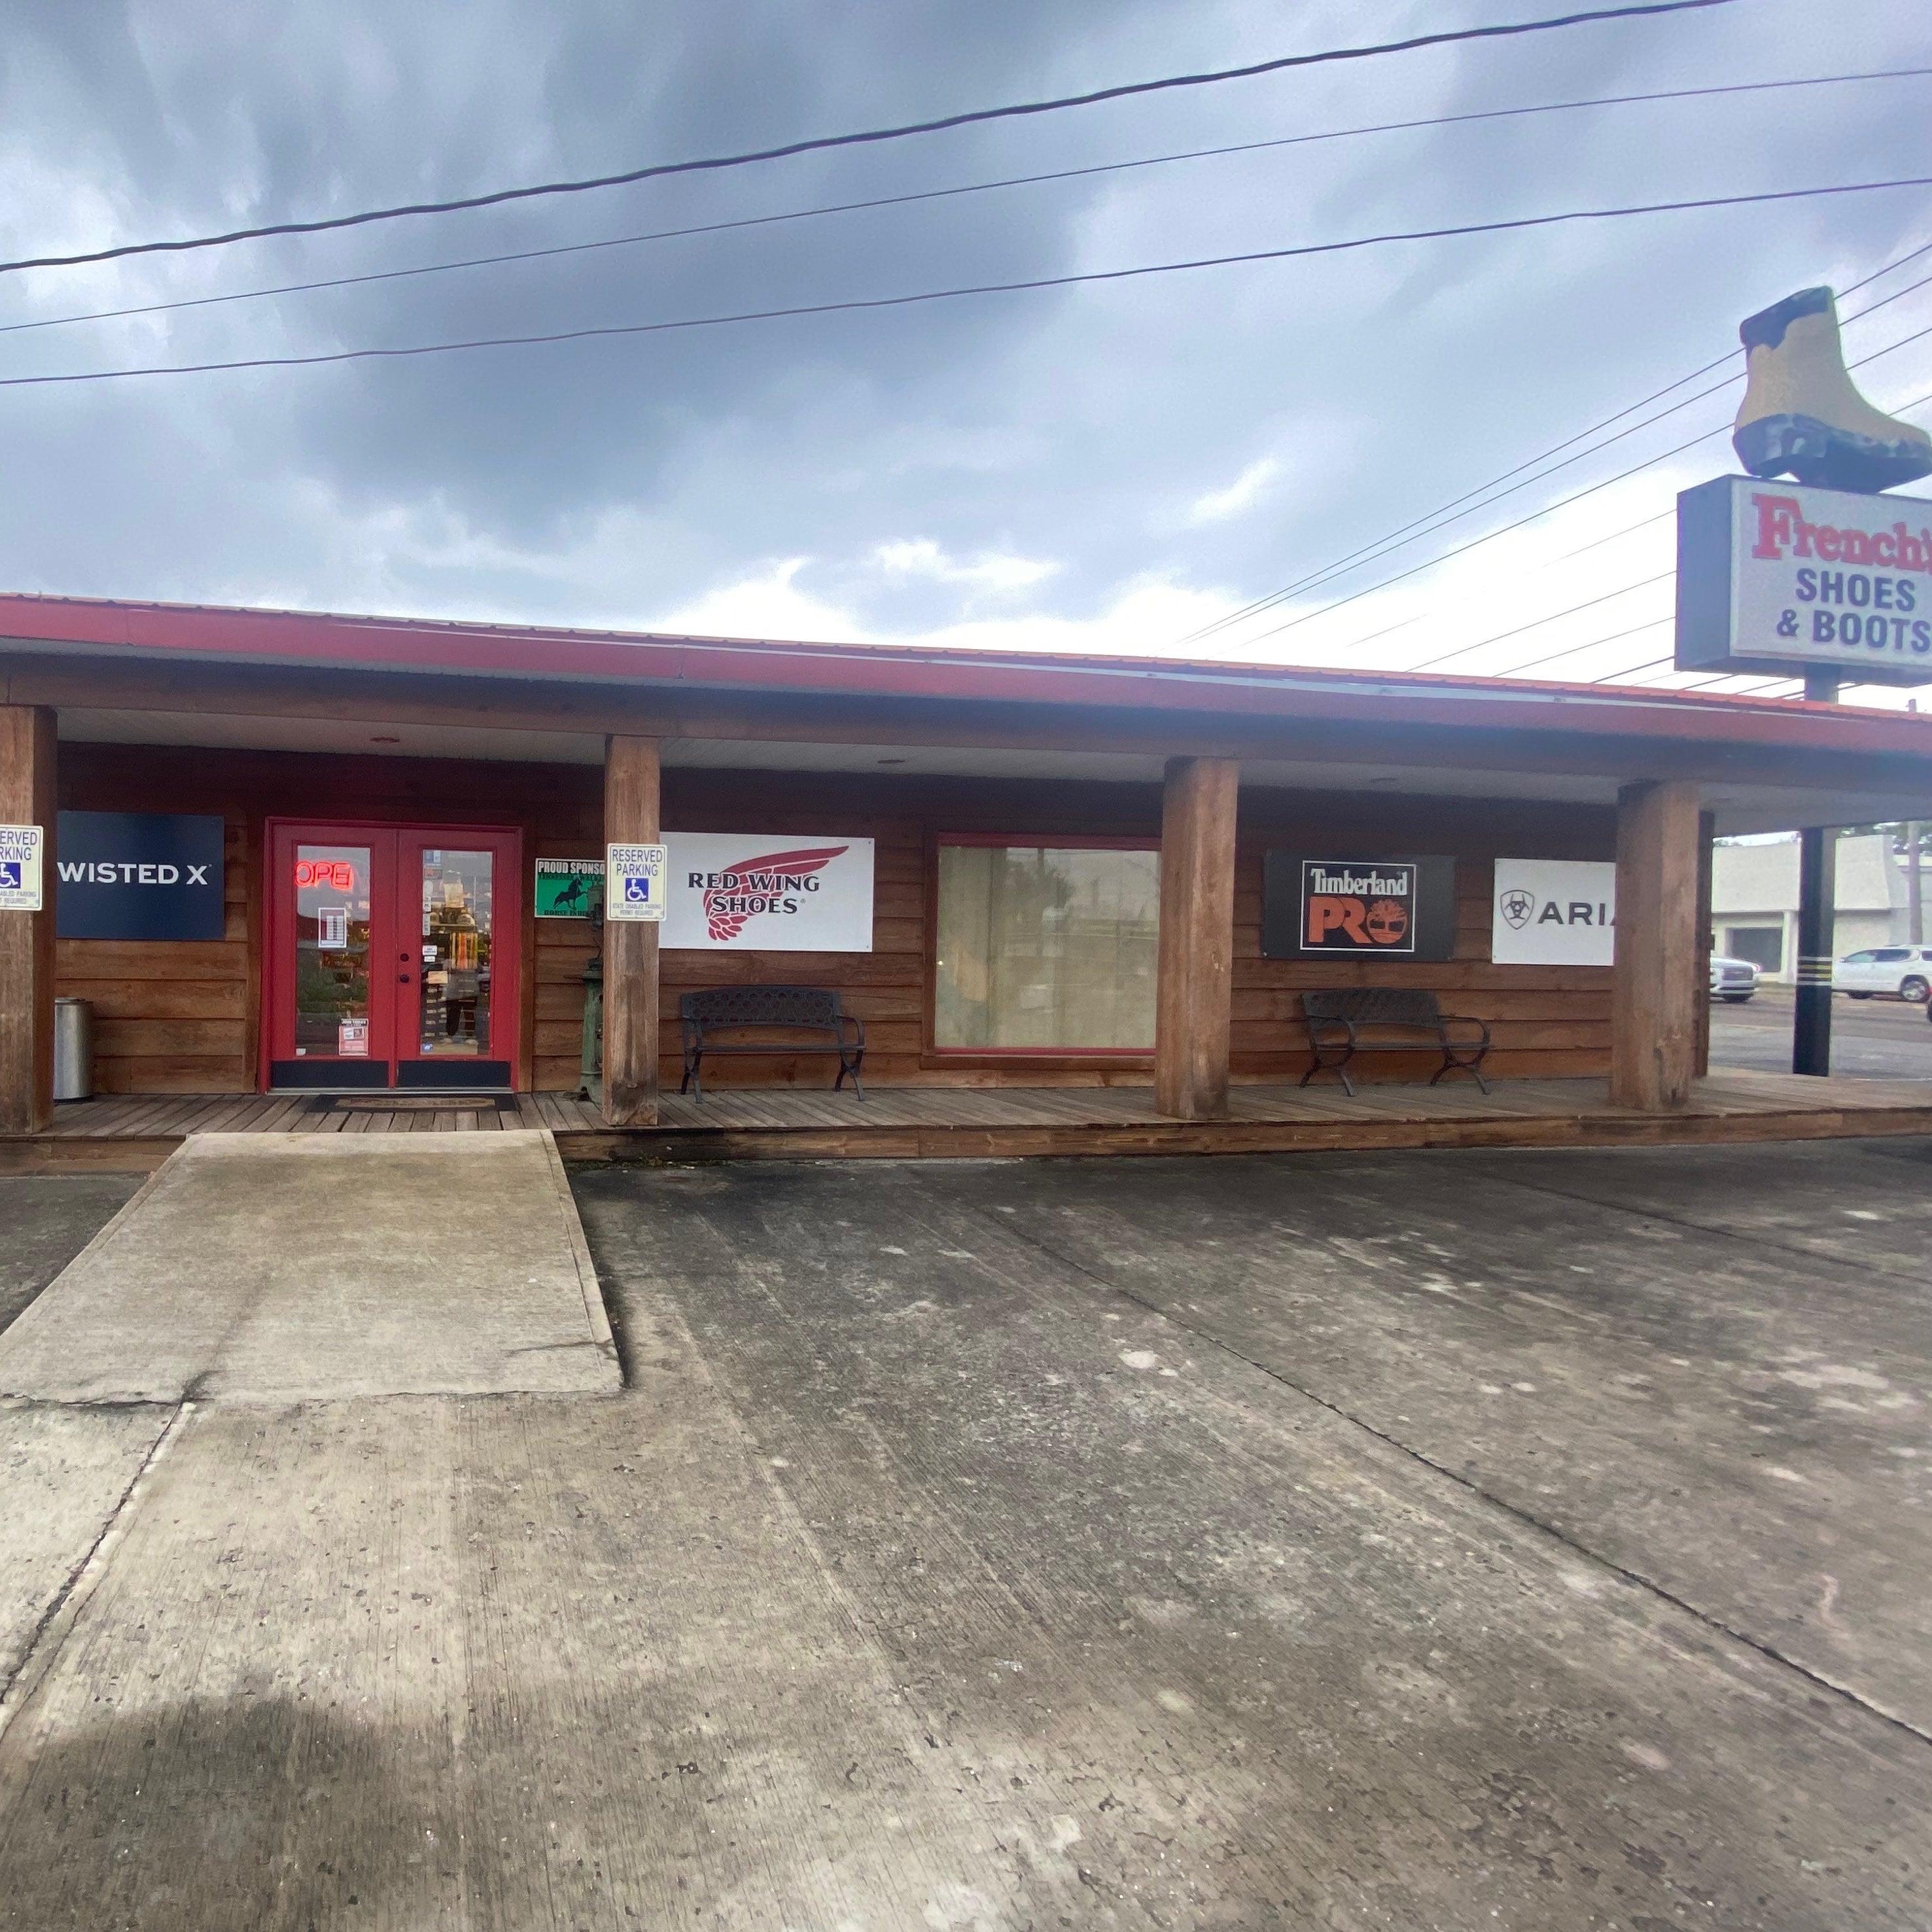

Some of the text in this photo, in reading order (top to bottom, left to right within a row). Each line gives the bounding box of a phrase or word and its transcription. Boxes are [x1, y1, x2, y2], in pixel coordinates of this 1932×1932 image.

[1751, 493, 1932, 575] French'
[1795, 568, 1916, 612] SHOES
[1776, 609, 1931, 653] & BOOTS
[538, 861, 569, 873] PROUD
[612, 849, 662, 862] RESERVED
[57, 862, 208, 885] WISTED X
[296, 860, 354, 890] OPE
[616, 864, 658, 876] PARKING
[688, 873, 820, 892] RED WING
[1310, 868, 1407, 896] Timberland
[711, 896, 798, 914] SHOES
